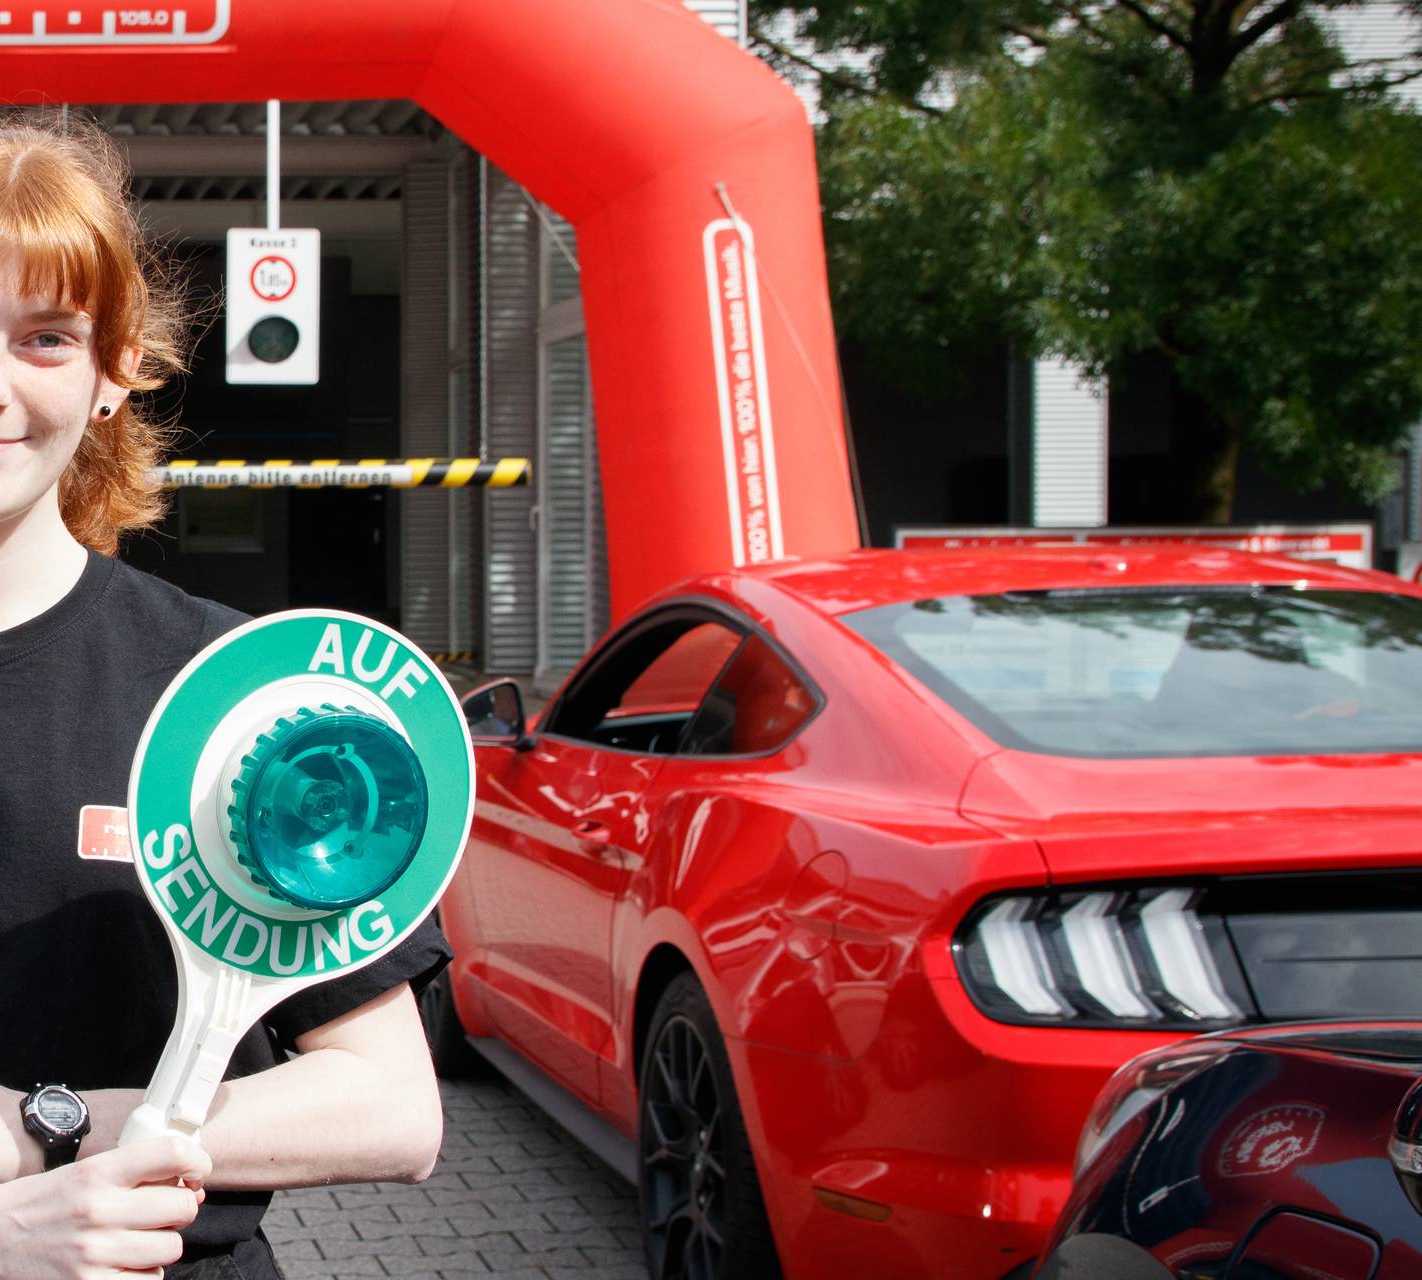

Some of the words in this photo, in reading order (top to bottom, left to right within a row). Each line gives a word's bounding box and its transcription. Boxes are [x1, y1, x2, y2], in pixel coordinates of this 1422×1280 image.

[119, 10, 169, 26] 105.0
[730, 299, 749, 351] beste
[732, 351, 752, 380] die
[734, 379, 756, 435] 100%
[162, 471, 240, 485] Antenne
[248, 471, 292, 485] bitte
[300, 470, 393, 485] entfernen
[746, 509, 768, 564] 100%
[308, 623, 429, 700] AUF
[143, 823, 395, 975] SENDUNG
